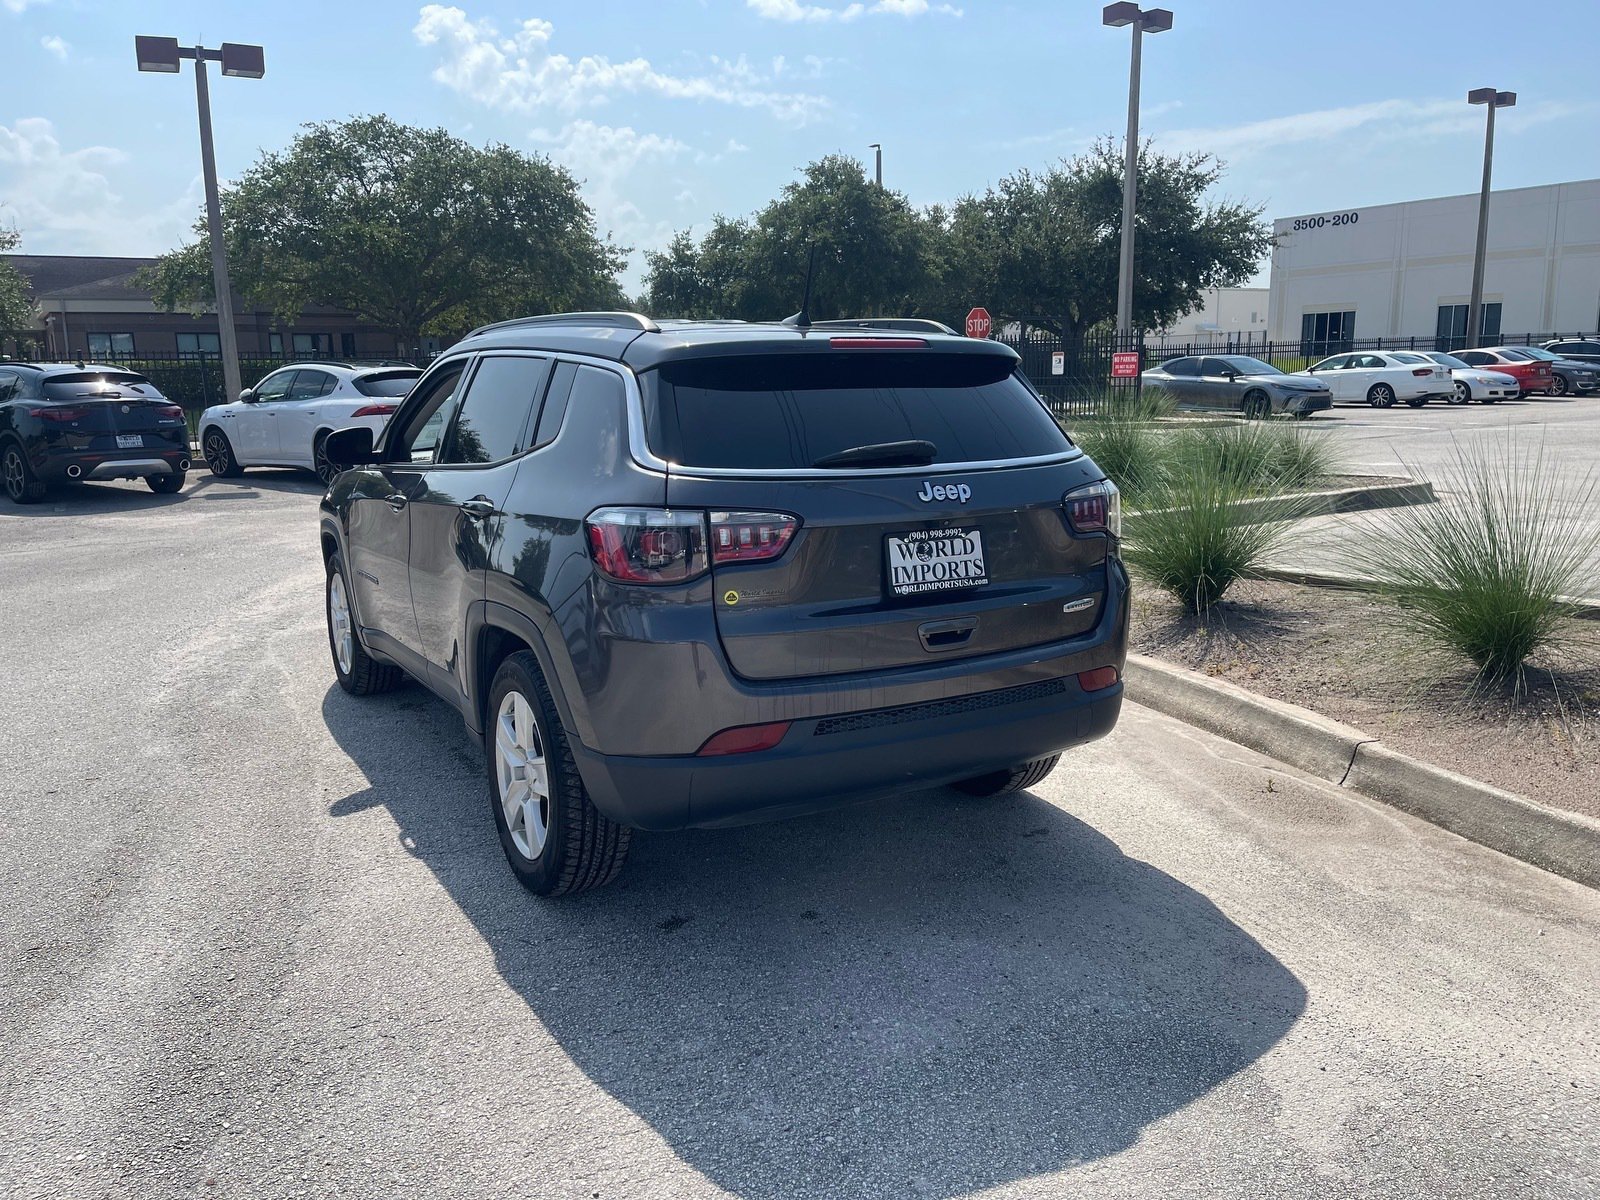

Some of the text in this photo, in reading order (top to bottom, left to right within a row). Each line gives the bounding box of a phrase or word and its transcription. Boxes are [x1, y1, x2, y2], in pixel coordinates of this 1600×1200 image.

[1293, 212, 1358, 230] 3500-200
[968, 318, 989, 331] STOP
[918, 481, 971, 503] Jeep
[908, 528, 962, 541] (904) 998-9992
[896, 538, 975, 562] WORLD
[893, 558, 983, 585] IMPORTS
[894, 578, 989, 595] WORLDIMPORTSUSA.com
